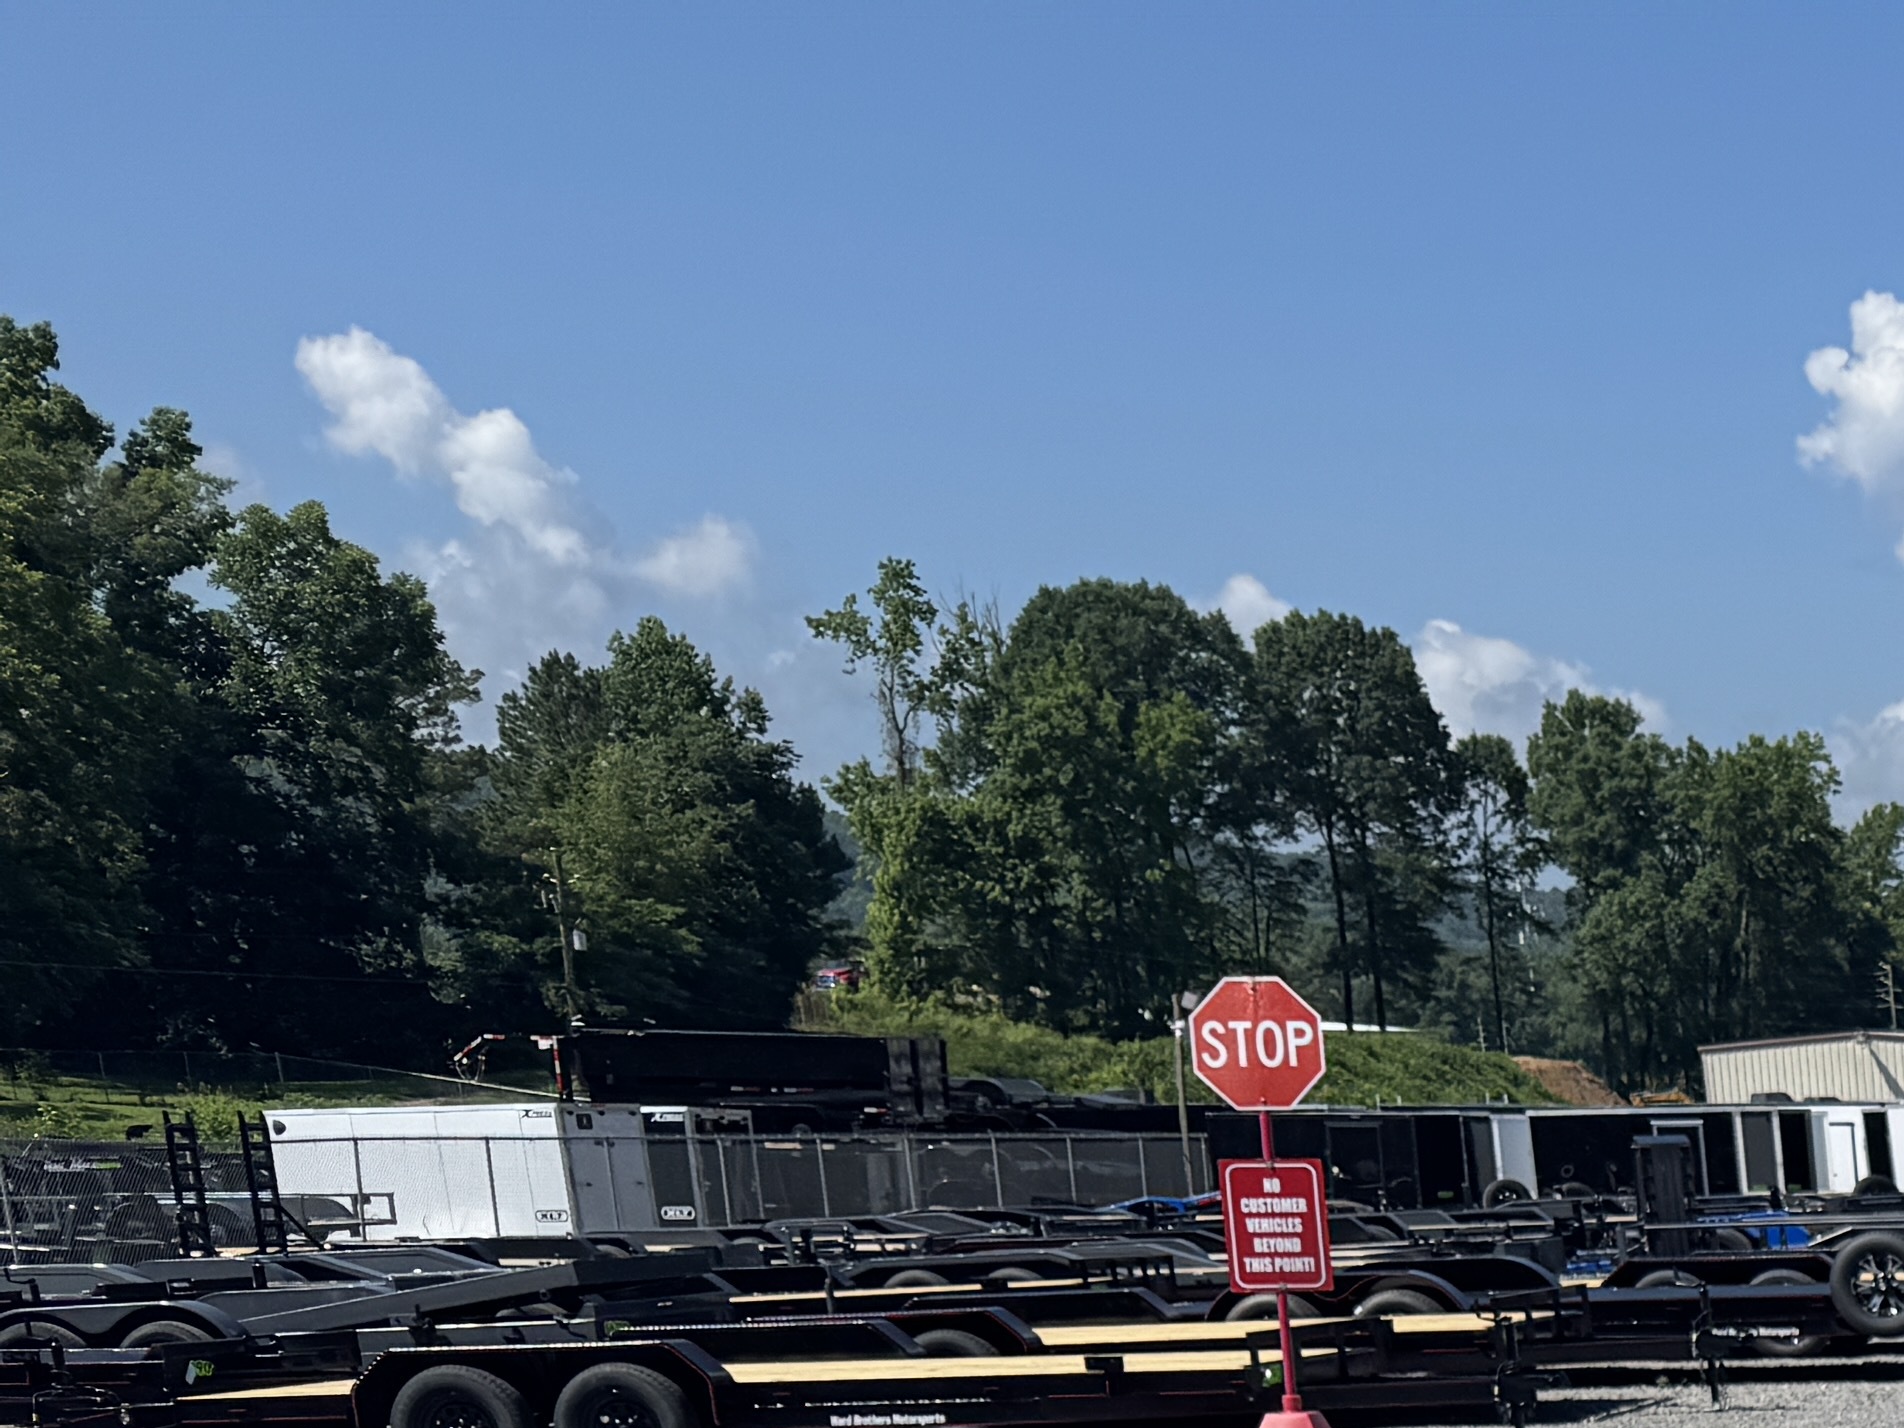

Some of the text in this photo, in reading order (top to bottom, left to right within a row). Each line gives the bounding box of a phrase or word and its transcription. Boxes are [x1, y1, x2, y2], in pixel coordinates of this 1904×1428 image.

[1201, 1019, 1314, 1069] STOP
[1263, 1178, 1281, 1193] NO
[1240, 1197, 1308, 1213] CUSTOMER
[1245, 1217, 1303, 1233] VEHICLES
[1253, 1237, 1302, 1253] BEYOND
[1243, 1256, 1316, 1273] THIS POINT!
